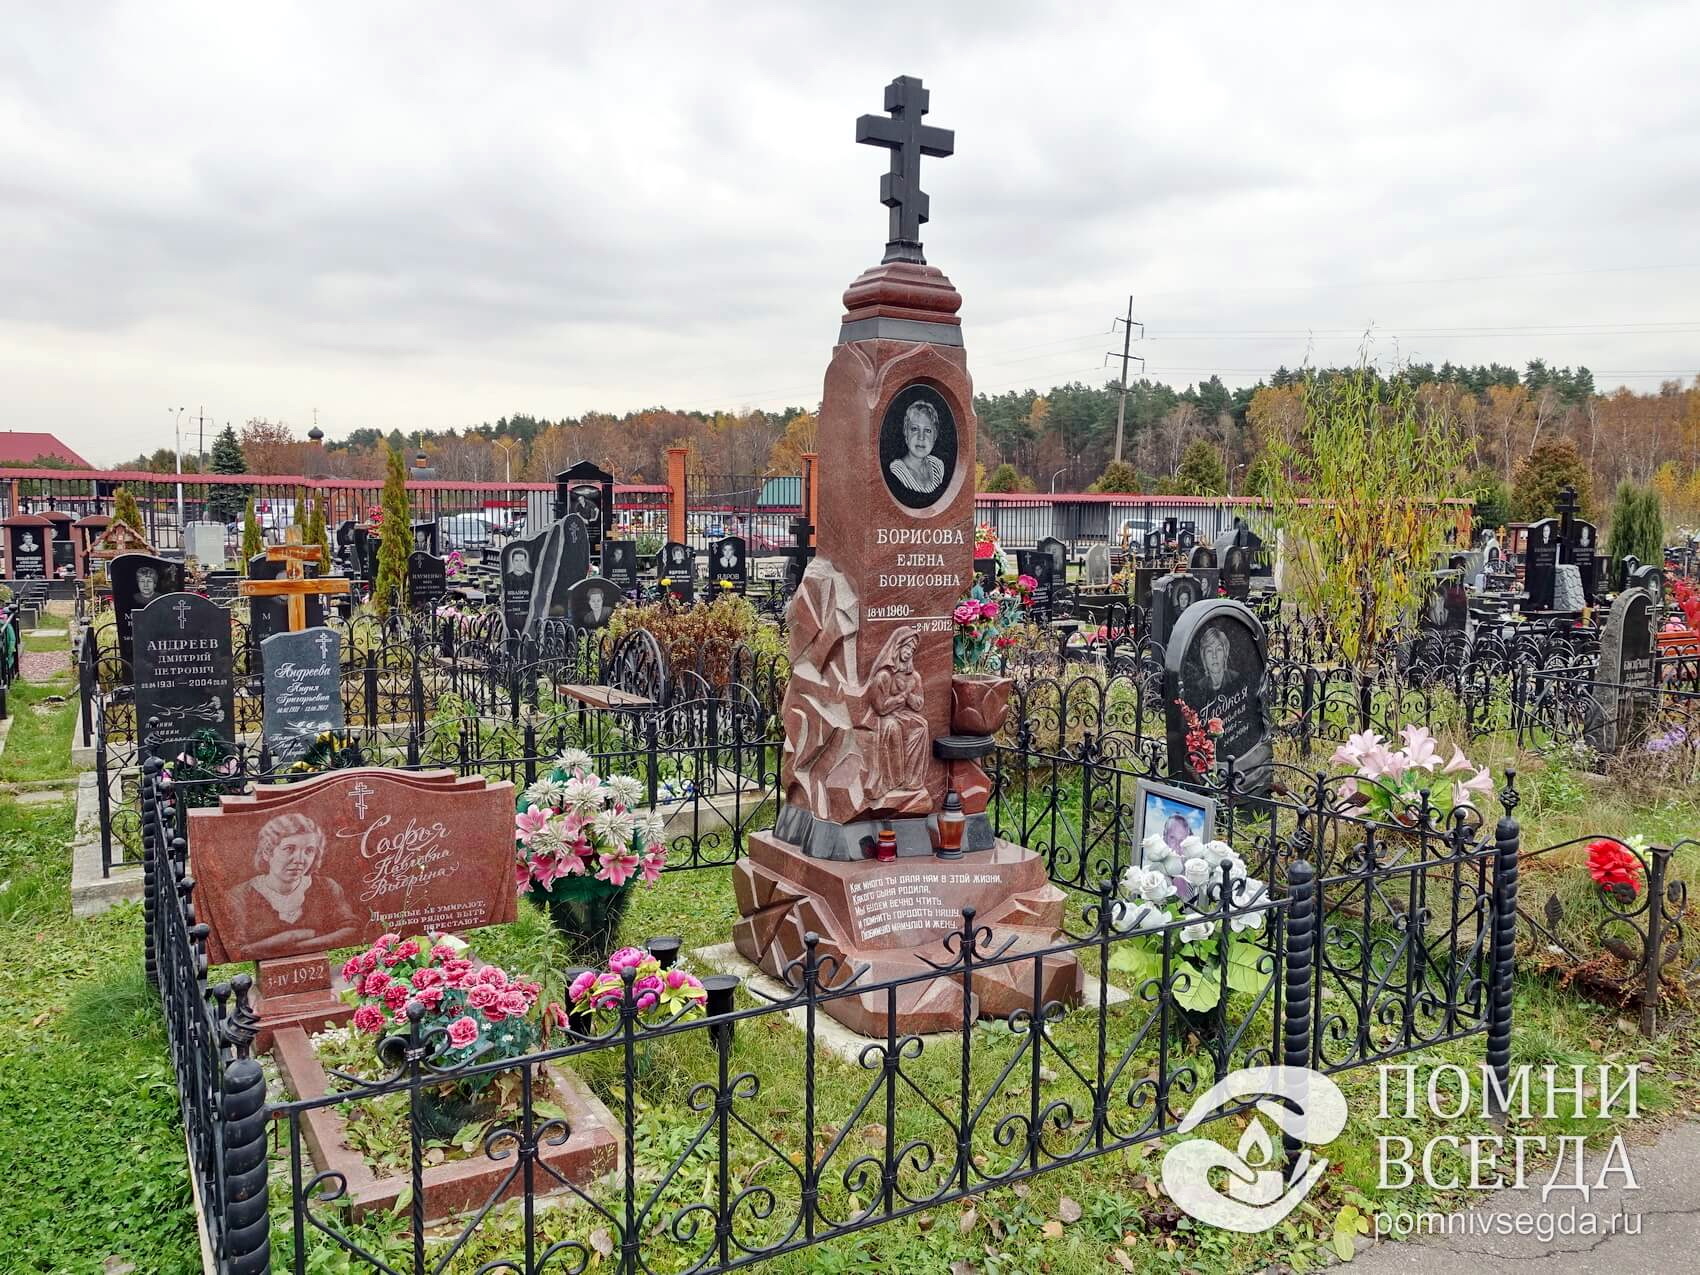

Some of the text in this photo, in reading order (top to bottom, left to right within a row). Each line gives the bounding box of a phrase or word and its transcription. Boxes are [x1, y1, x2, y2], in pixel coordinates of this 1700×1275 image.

[876, 528, 964, 544] БОРИСОВА
[896, 554, 945, 566] ЕЛЕНА
[879, 574, 961, 587] БОРИСОВНА
[931, 620, 953, 632] 2012
[147, 638, 219, 651] АНДРЕЕВ
[158, 652, 212, 664] ДМИТРИЙ
[154, 666, 214, 676] ПЕТРОВИЧ
[274, 662, 331, 681] Андреева
[188, 679, 213, 687] 2004
[885, 876, 897, 887] ТЫ
[899, 874, 921, 884] ДАЛА
[922, 874, 939, 884] НАМ
[949, 873, 970, 884] ЭТОЙ
[421, 913, 454, 923] РЯДОМ
[456, 908, 486, 919] БЫТЬ
[293, 965, 325, 984] 1922
